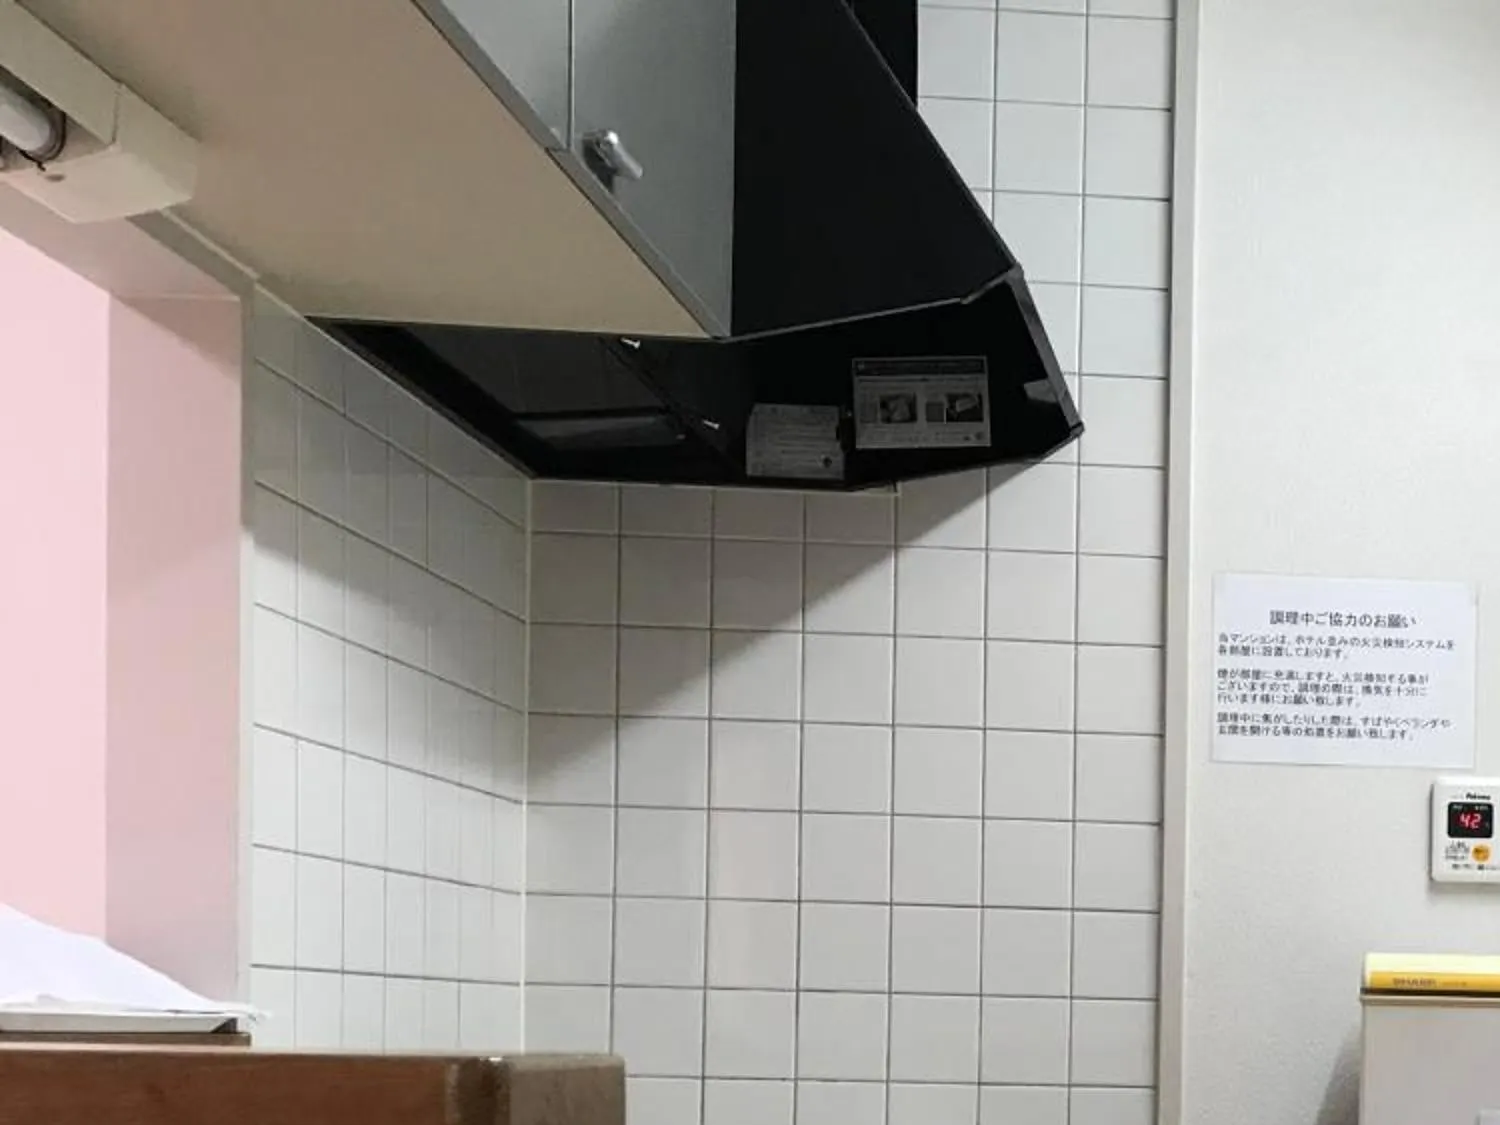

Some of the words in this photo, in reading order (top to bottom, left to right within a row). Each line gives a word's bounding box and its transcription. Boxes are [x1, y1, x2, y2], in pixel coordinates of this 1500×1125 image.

[1269, 609, 1417, 628] 調理中ご協力のお願い
[1459, 812, 1481, 829] 42
